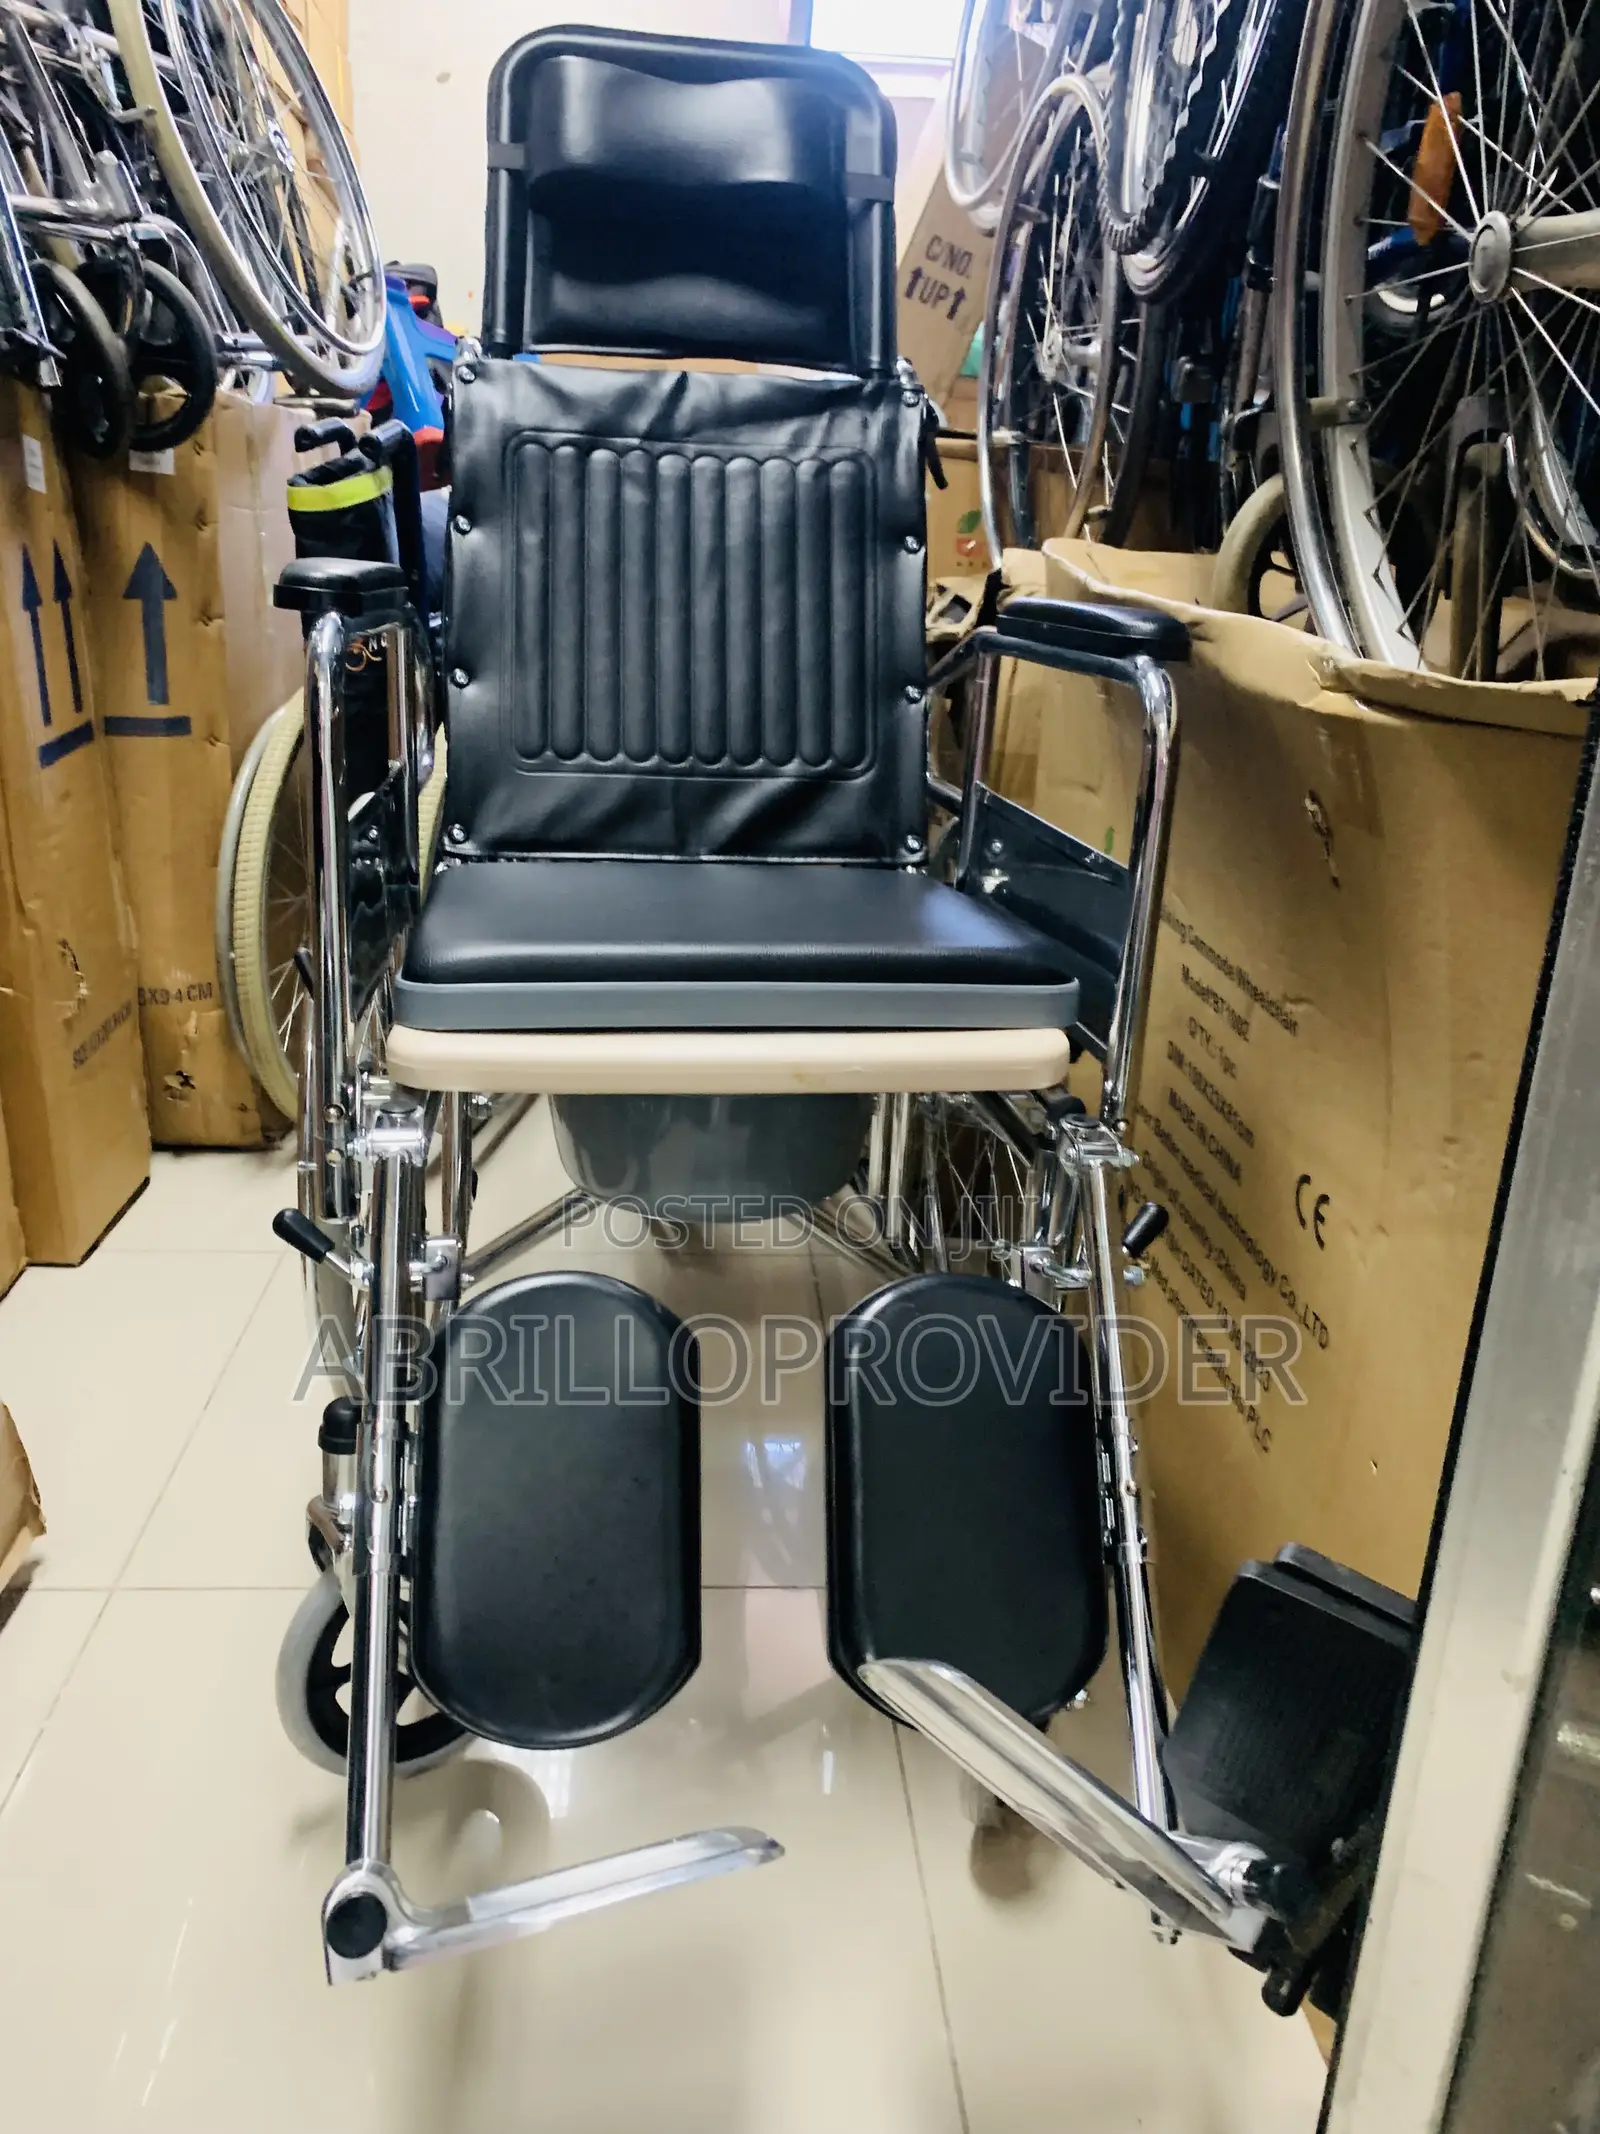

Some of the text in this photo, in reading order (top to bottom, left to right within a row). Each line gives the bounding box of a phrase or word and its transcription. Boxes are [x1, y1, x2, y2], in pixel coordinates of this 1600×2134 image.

[918, 276, 950, 310] UP
[1168, 1087, 1196, 1132] MADE
[1207, 1132, 1243, 1187] CHINA
